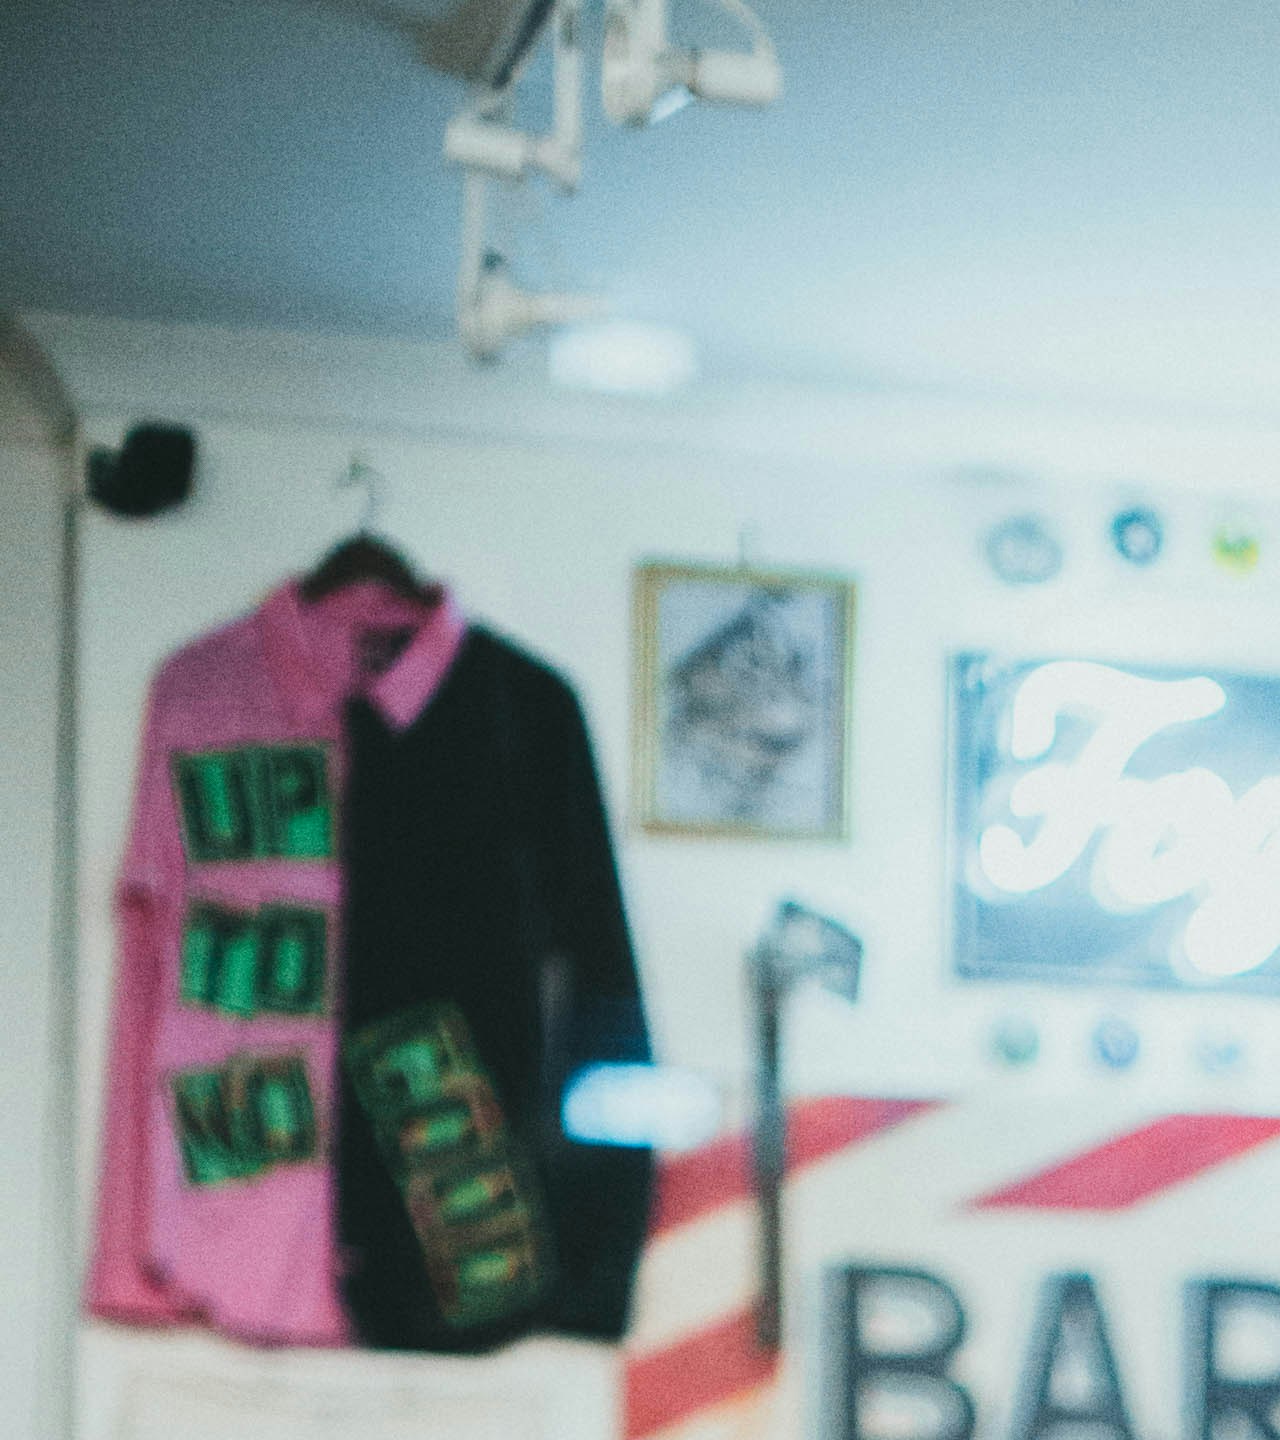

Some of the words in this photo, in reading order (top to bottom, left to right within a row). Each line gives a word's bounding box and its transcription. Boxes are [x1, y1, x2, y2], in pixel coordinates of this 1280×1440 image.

[177, 744, 330, 862] UP
[180, 904, 326, 1016] TO
[172, 1056, 316, 1184] NO
